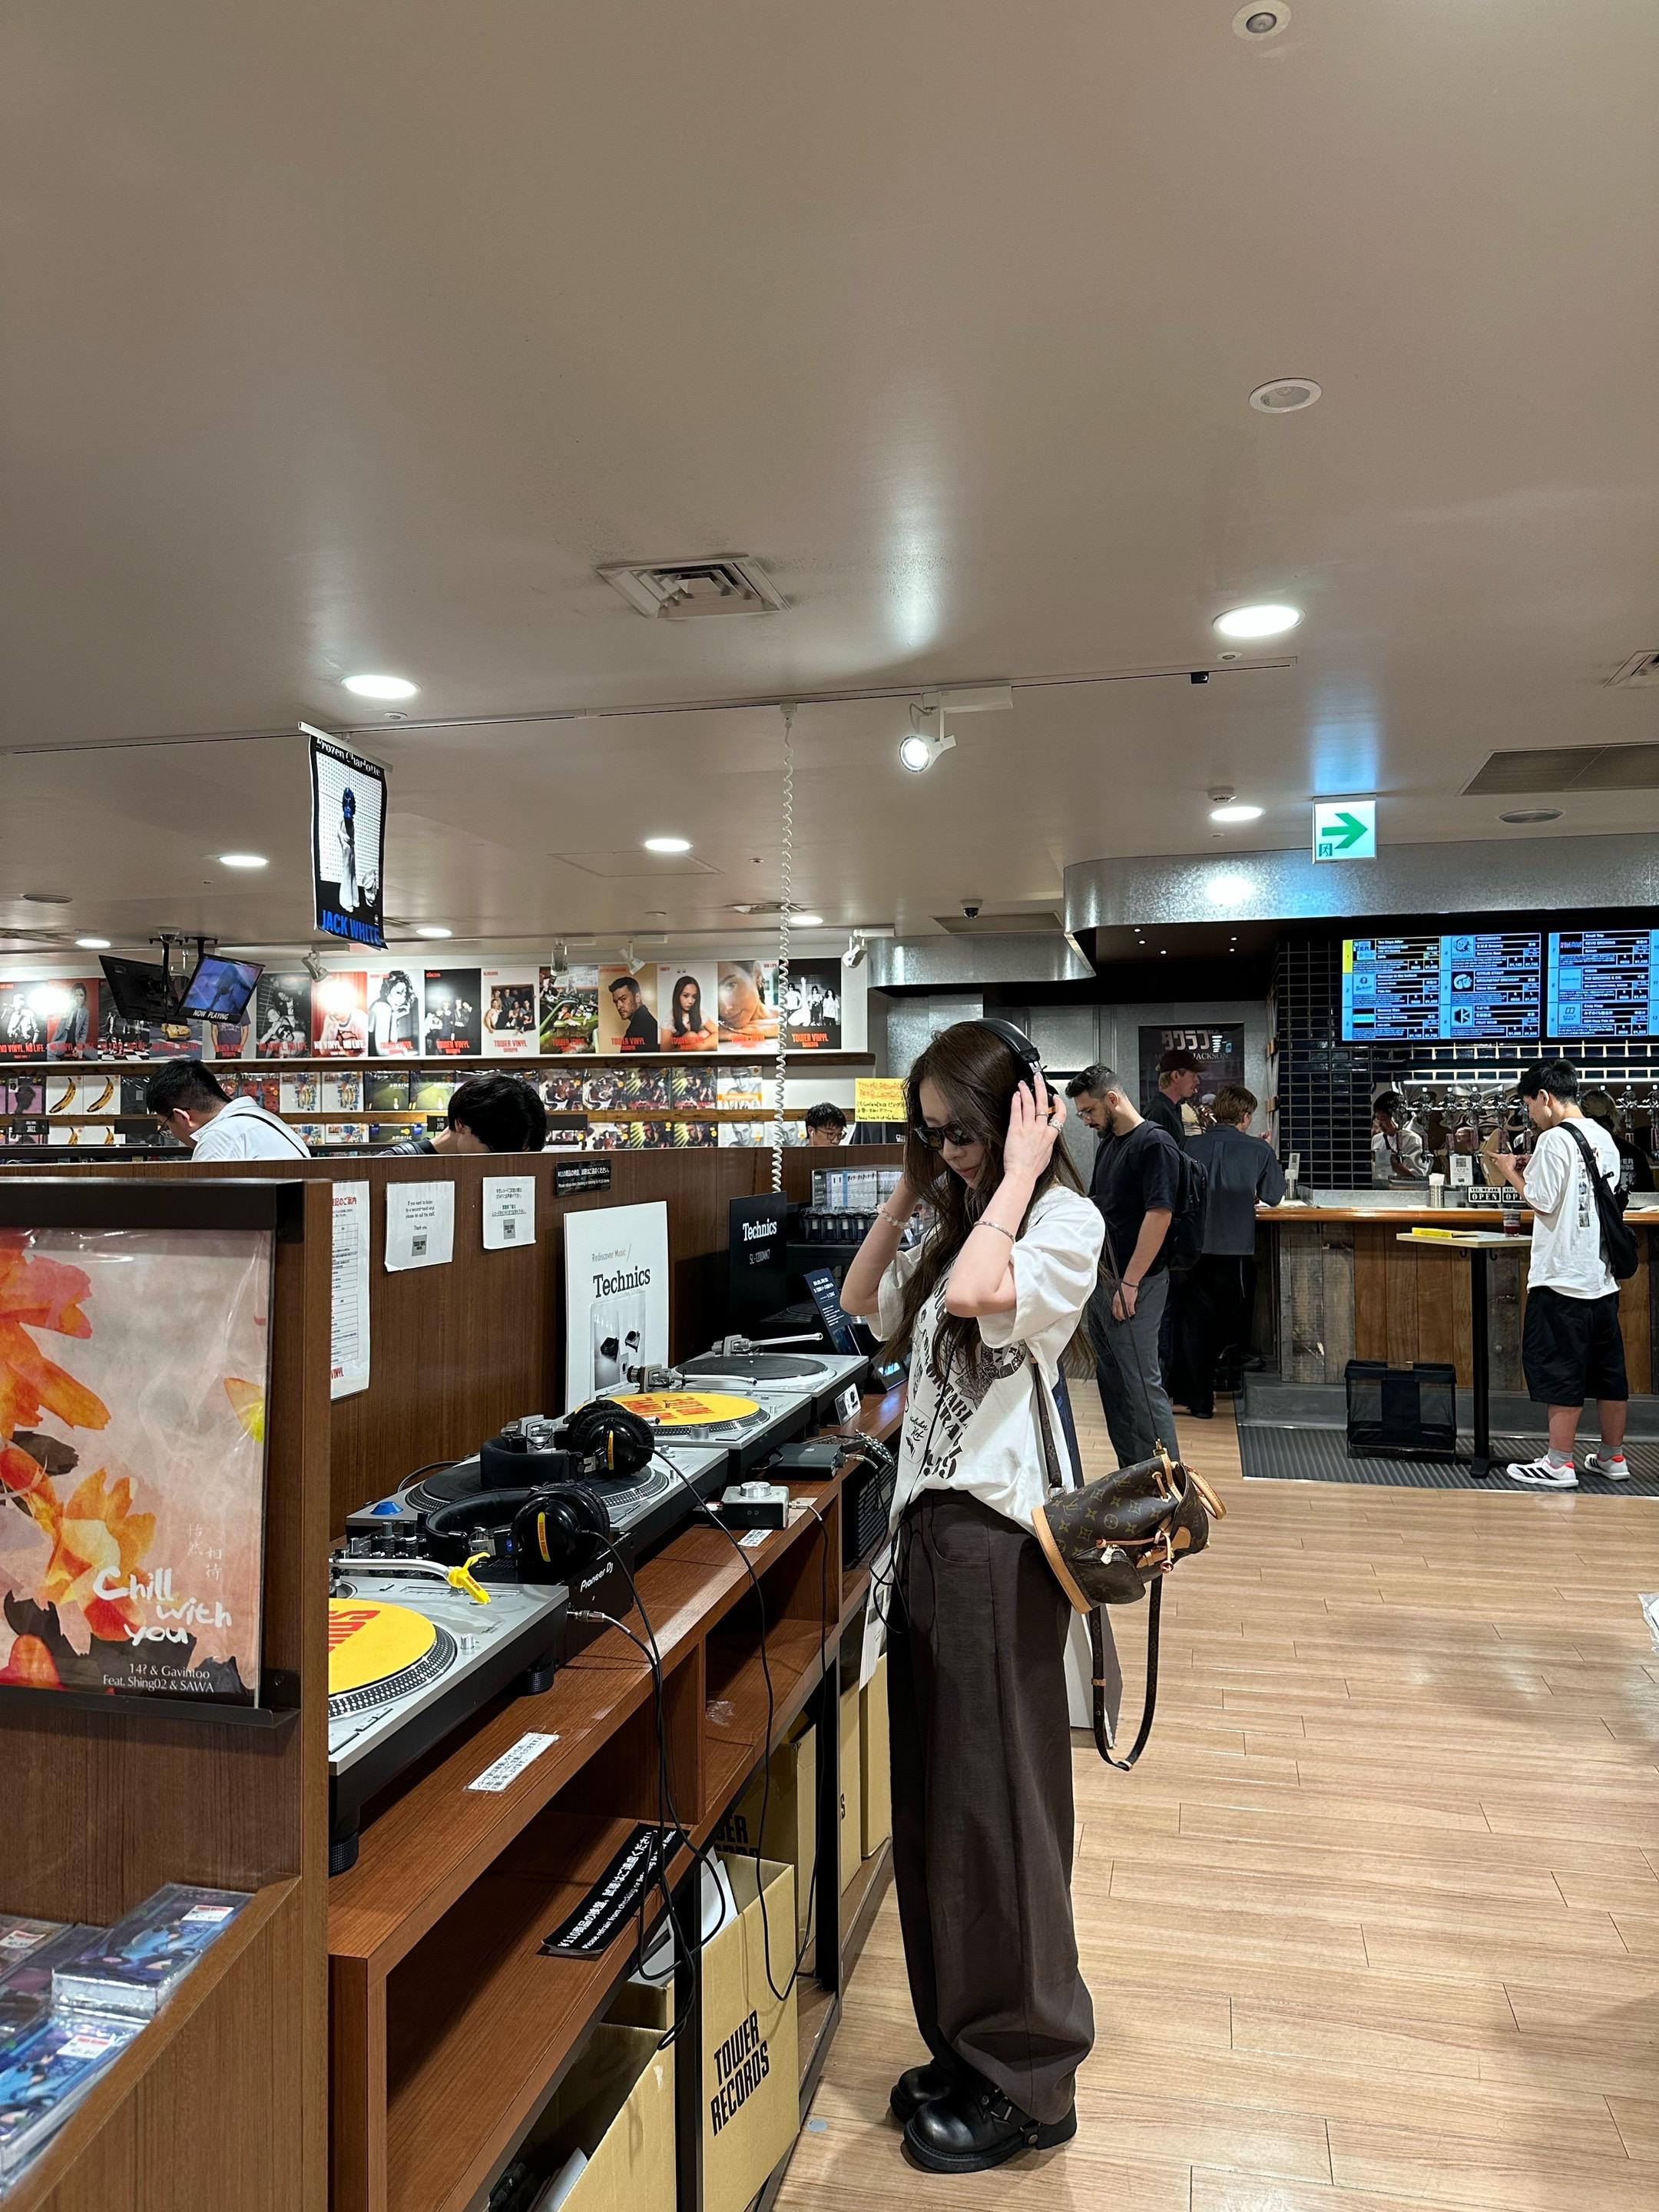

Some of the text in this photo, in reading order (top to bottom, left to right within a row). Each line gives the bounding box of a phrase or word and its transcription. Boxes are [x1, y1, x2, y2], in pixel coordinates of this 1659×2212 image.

[321, 909, 382, 945] JACK WHITE
[193, 1009, 230, 1021] NOW PLAYING
[512, 1039, 528, 1048] VINYL
[629, 1037, 646, 1045] VINYL
[792, 1033, 829, 1042] TOWER VINYL
[742, 1217, 777, 1241] Technics
[591, 1249, 626, 1263] Rediscover Music
[592, 1265, 651, 1298] Technics
[332, 1367, 344, 1379] VINYL
[93, 1565, 174, 1601] Chill
[580, 1561, 614, 1592] Pioneer DJ
[156, 1597, 232, 1628] with
[124, 1624, 189, 1646] you
[129, 1664, 210, 1679] 14? & Gavintoo
[103, 1674, 214, 1693] Feat. Shing02 & SAWA
[582, 1936, 599, 1949] Please
[596, 1919, 612, 1937] refrain
[608, 1909, 621, 1922] from
[618, 1888, 638, 1909] checking
[714, 2009, 760, 2088] TOWER
[710, 2040, 770, 2137] RECORDS
